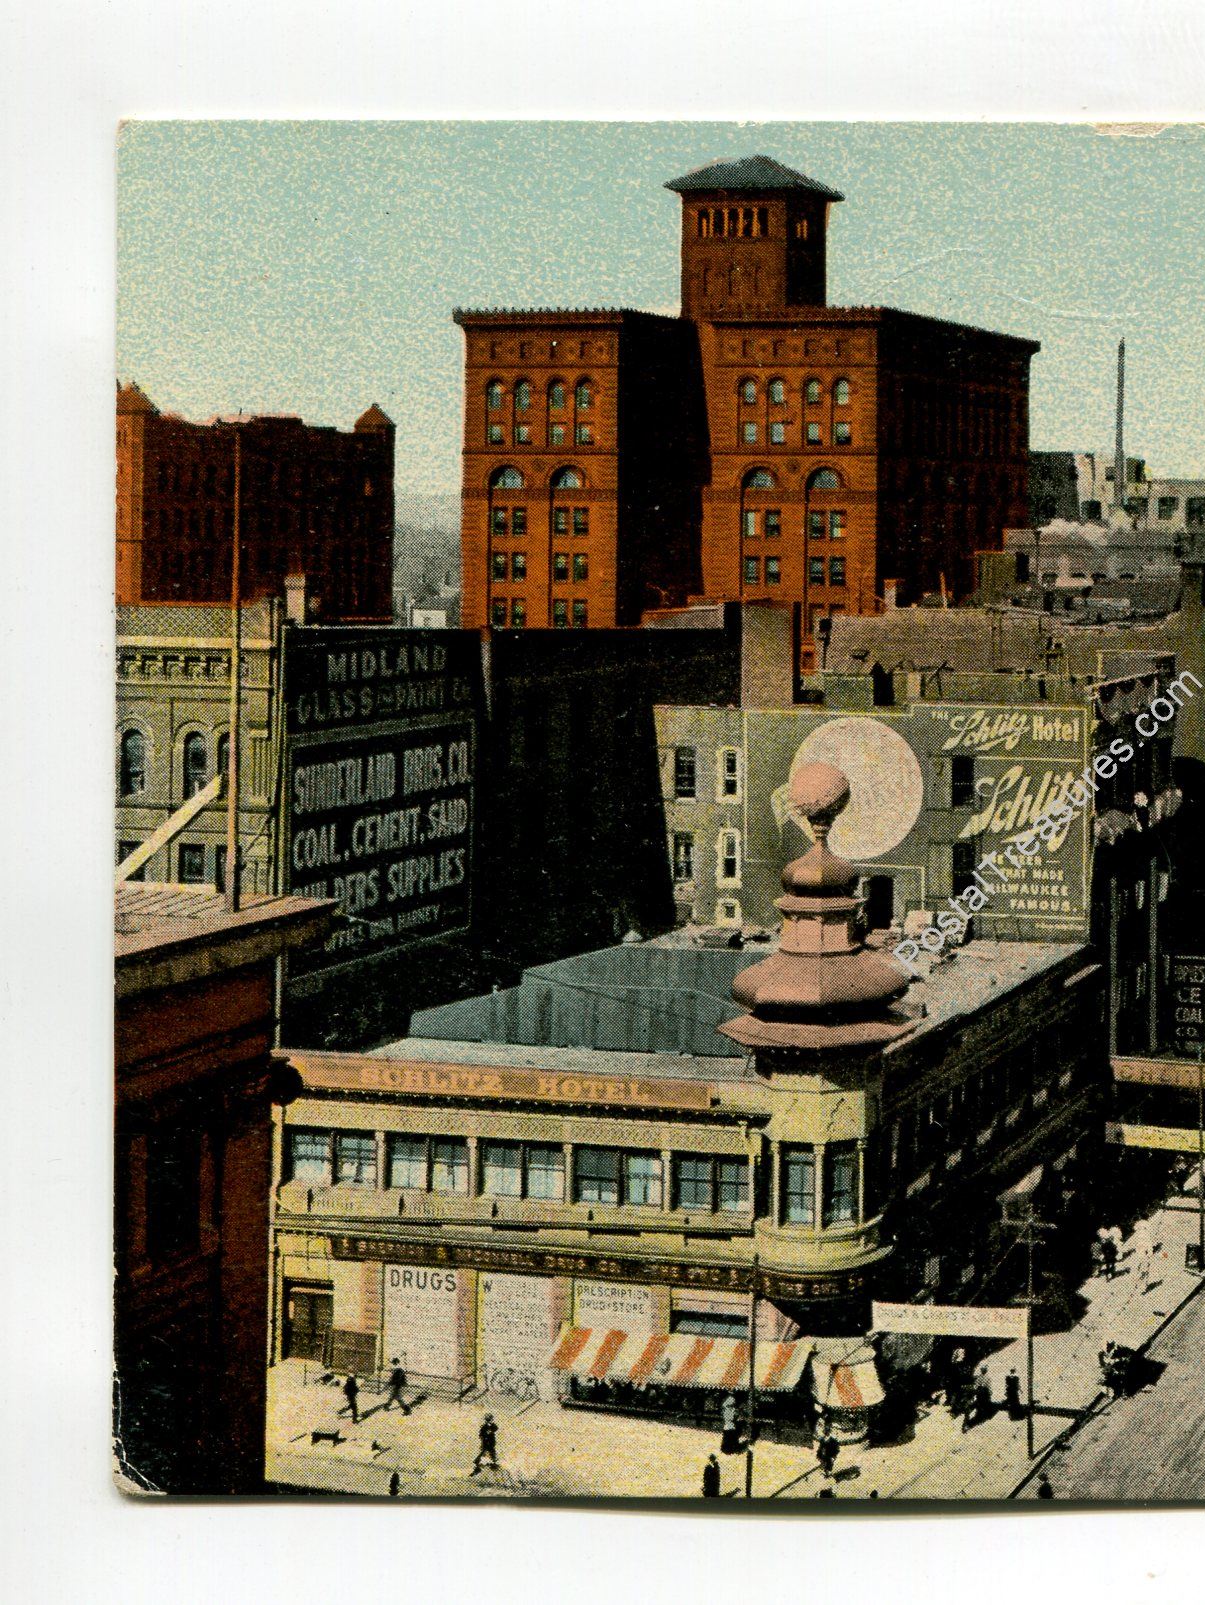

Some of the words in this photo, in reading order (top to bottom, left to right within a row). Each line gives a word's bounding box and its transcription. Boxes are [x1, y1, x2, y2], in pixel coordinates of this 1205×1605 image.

[327, 646, 448, 682] MIDLAND
[297, 686, 374, 725] GLASS
[930, 710, 950, 721] THE
[941, 710, 1031, 751] Schlitz
[1032, 716, 1081, 742] Hotel
[293, 752, 397, 815] SUNDERLAND
[958, 765, 1084, 853] Schlitz
[386, 848, 467, 904] SUPPLIES
[1032, 869, 1065, 881] MADE
[359, 1067, 503, 1093] SCHLITZ
[539, 1074, 652, 1099] HOTEL
[389, 1268, 458, 1293] DRUGS
